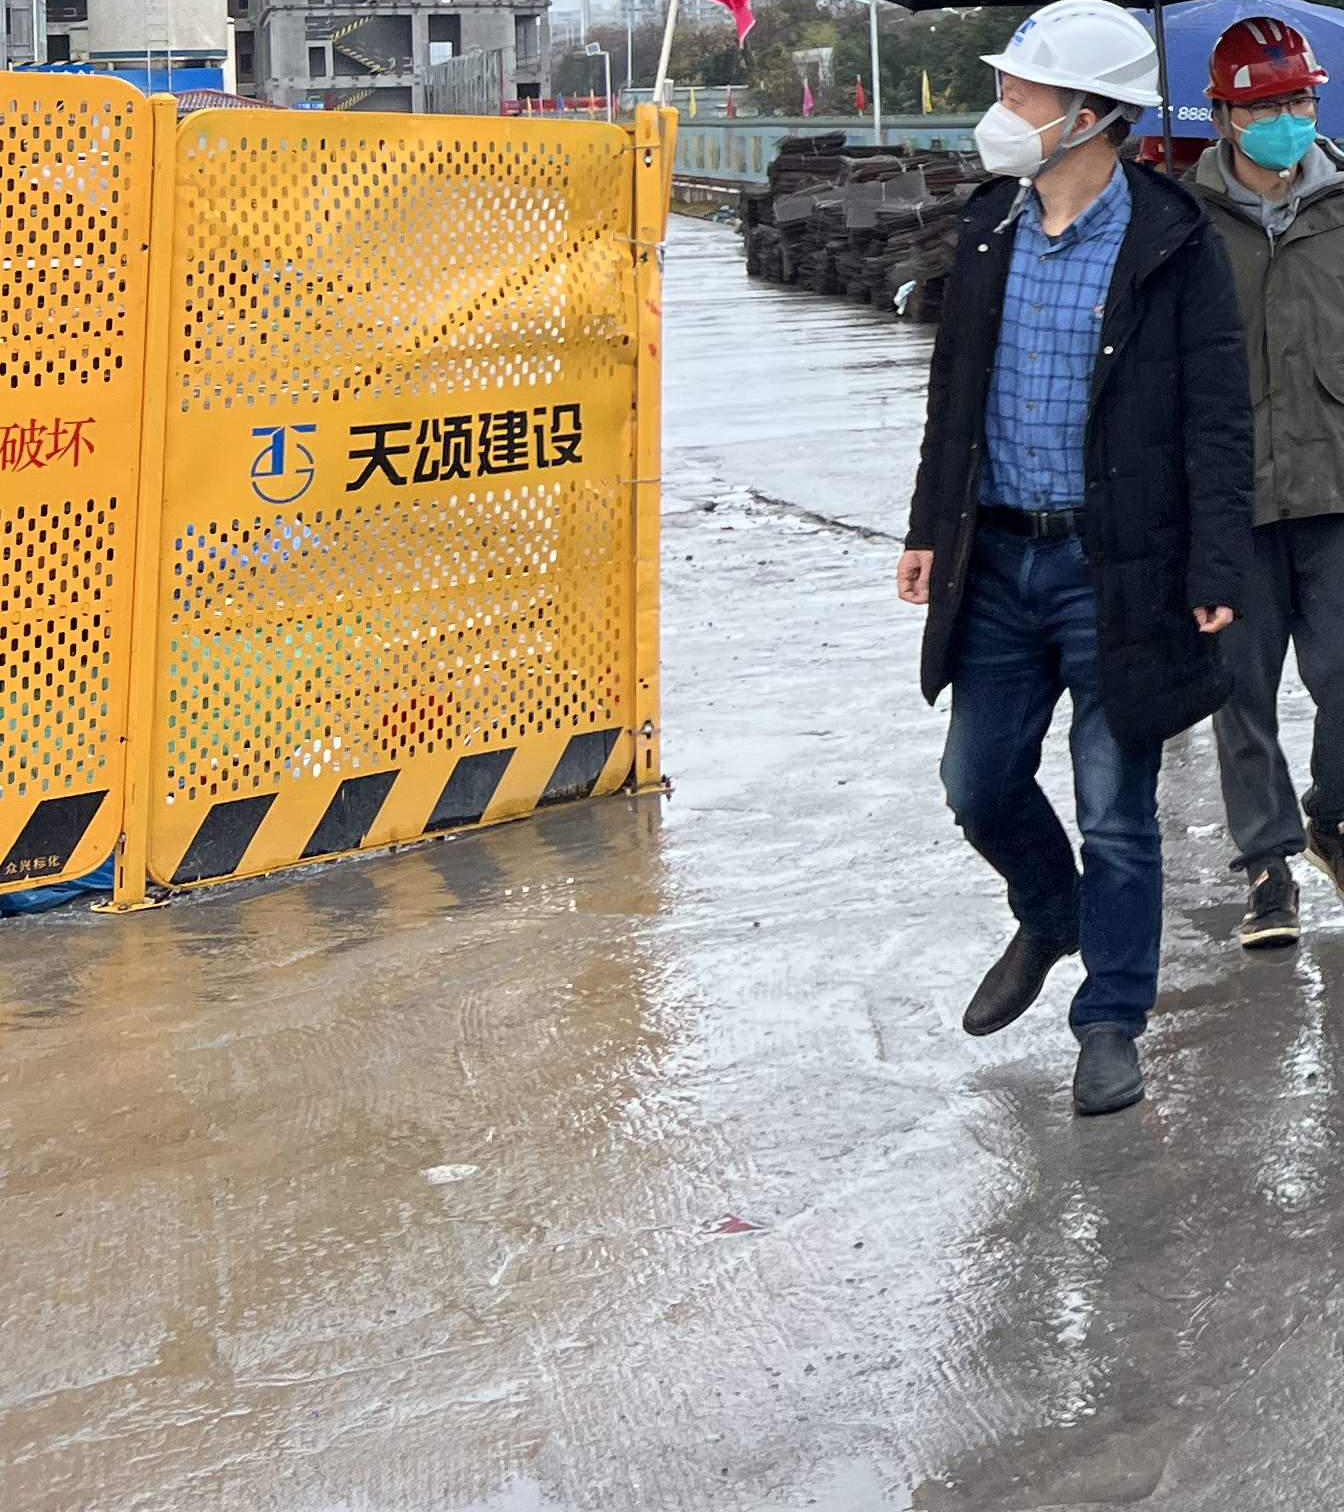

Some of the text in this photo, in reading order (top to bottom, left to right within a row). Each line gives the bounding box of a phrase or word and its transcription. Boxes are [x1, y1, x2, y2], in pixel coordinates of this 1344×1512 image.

[0, 416, 96, 472] 破坏
[345, 403, 583, 493] 天颂建设
